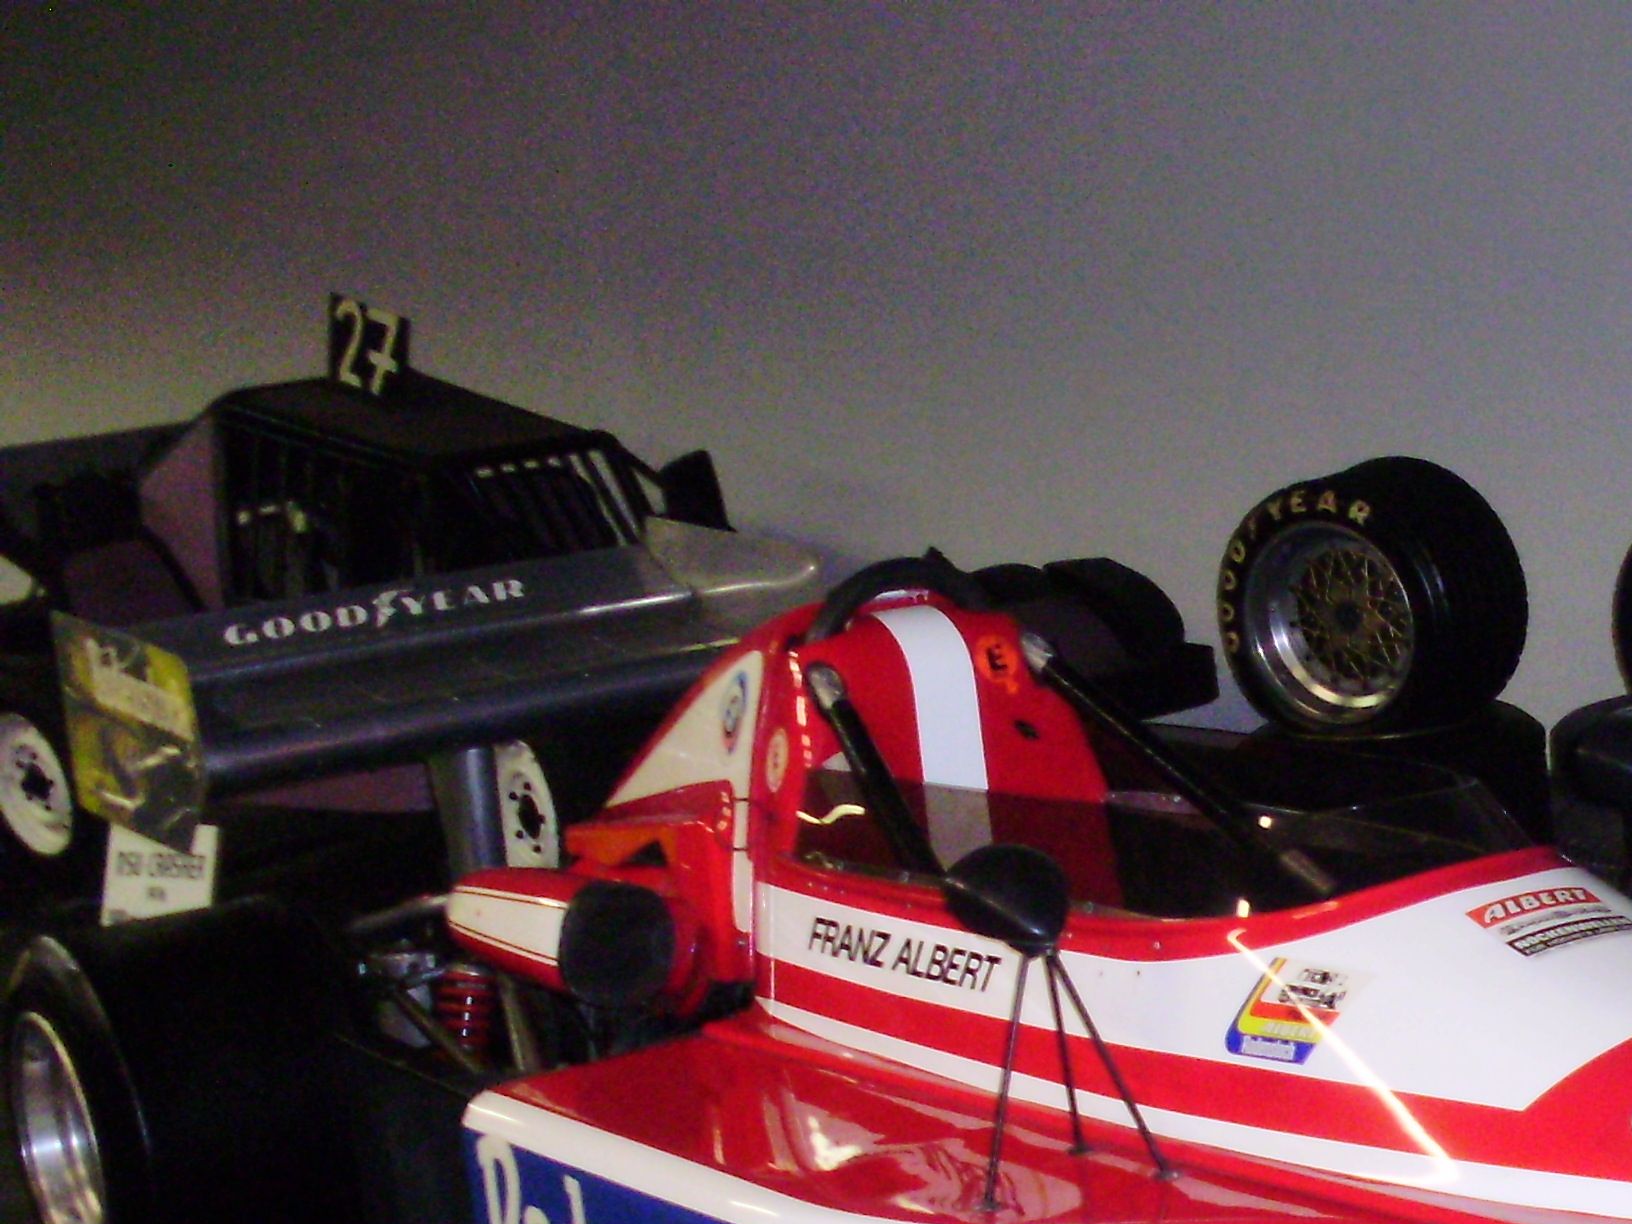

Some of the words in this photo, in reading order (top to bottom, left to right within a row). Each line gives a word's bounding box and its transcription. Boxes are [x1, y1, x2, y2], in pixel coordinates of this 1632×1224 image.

[336, 299, 399, 396] 27
[1217, 489, 1371, 654] GOODYEAR
[223, 579, 526, 646] GOODYEAR
[1483, 888, 1590, 924] ALBERT
[808, 917, 893, 969] FRANZ
[891, 938, 1003, 992] ALBERT
